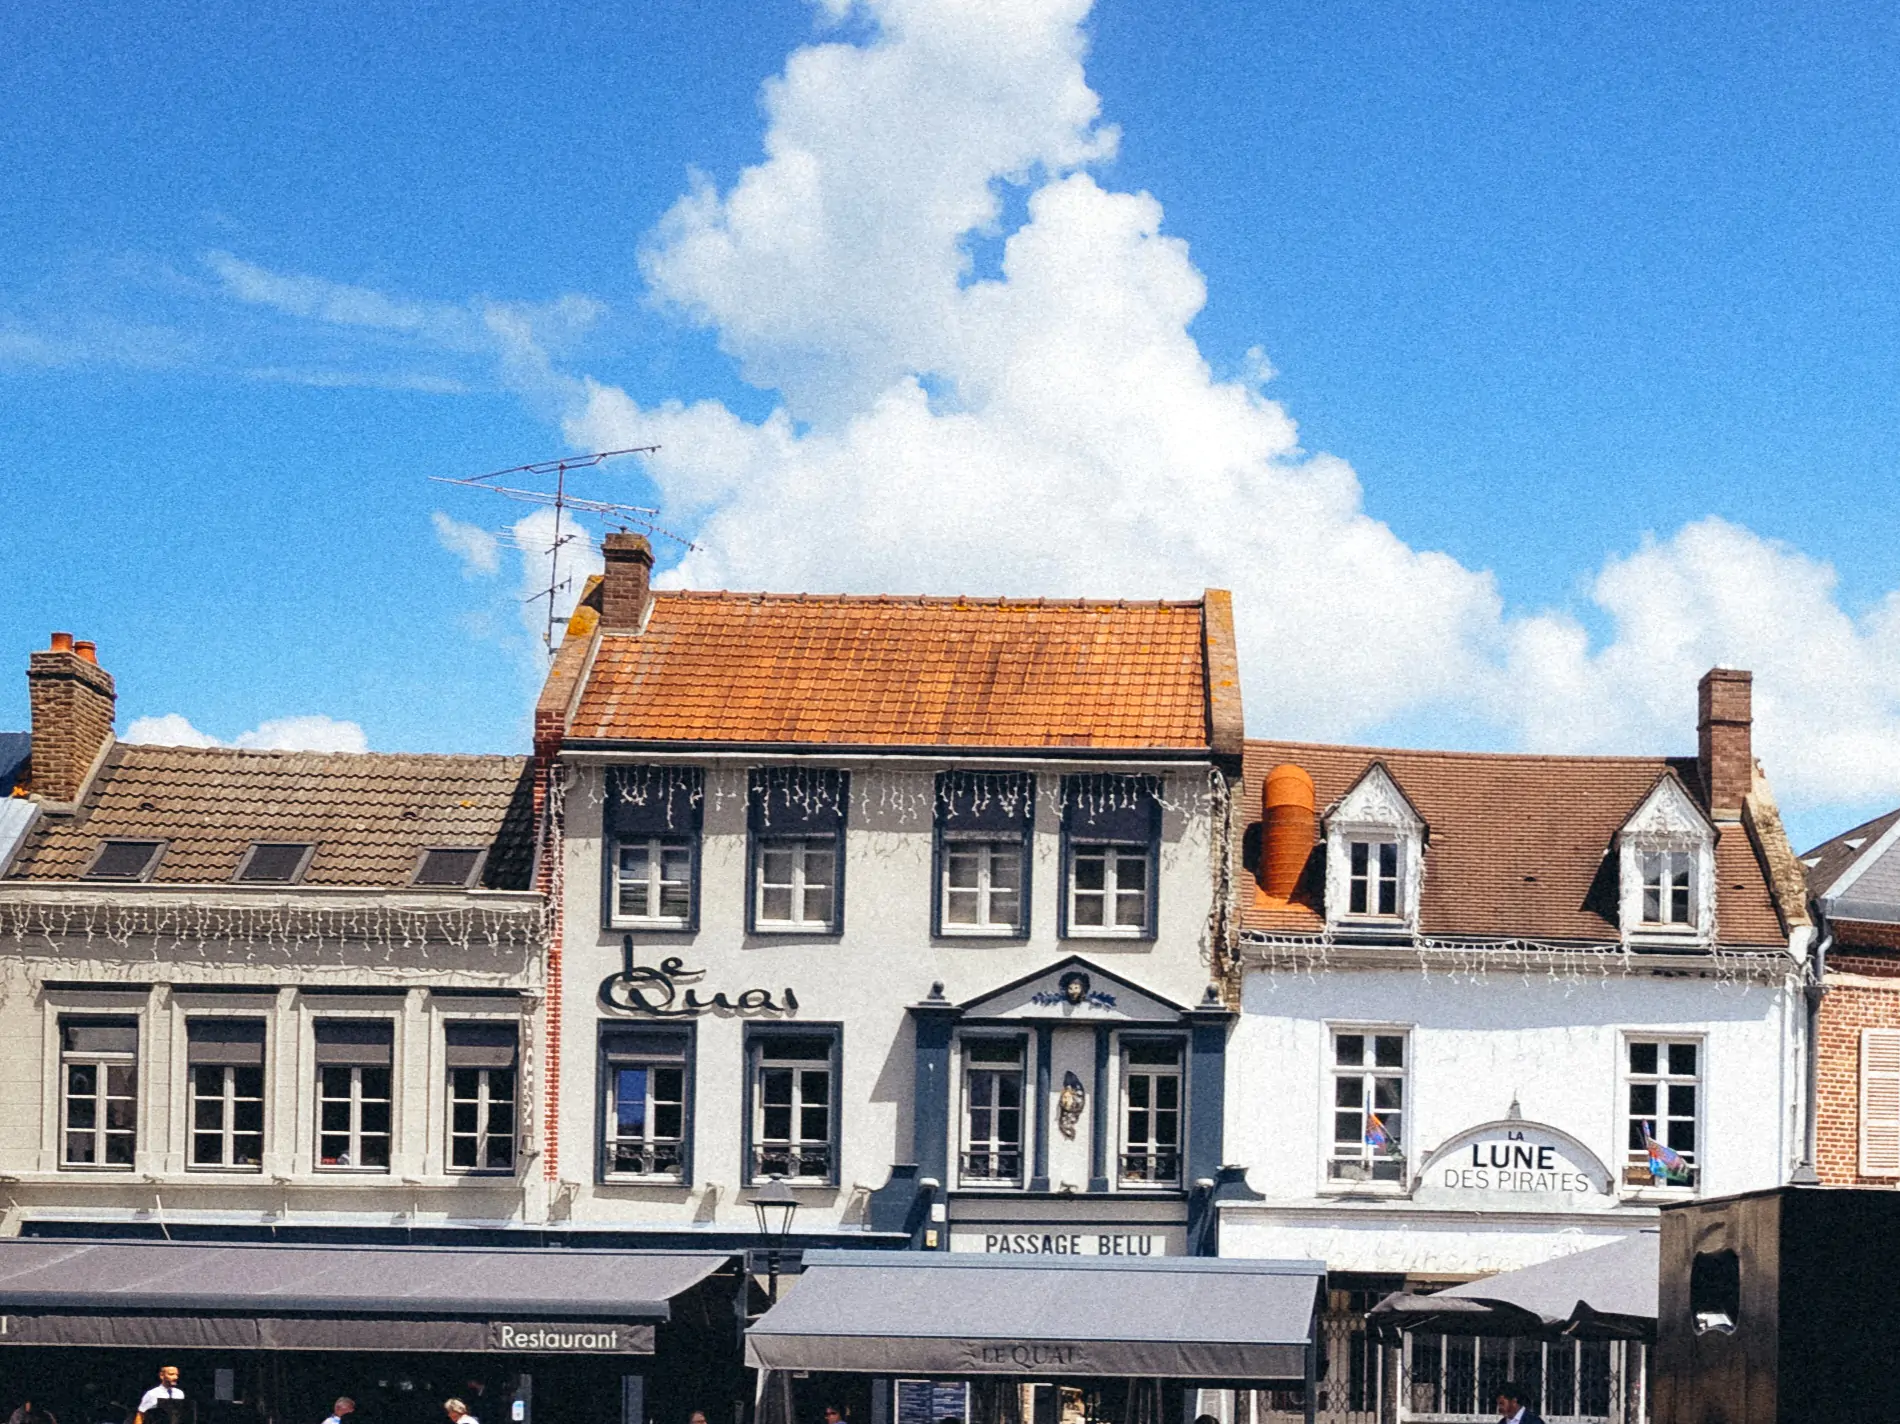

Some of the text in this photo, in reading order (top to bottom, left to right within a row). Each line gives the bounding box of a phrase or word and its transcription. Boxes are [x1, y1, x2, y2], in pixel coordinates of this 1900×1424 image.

[622, 934, 706, 982] Le
[600, 966, 799, 1015] Quai
[1508, 1130, 1525, 1141] LA
[1472, 1143, 1555, 1170] LUNE
[1444, 1169, 1589, 1193] DES PIRATES
[985, 1234, 1152, 1256] PASSAGE BELU
[501, 1325, 618, 1348] Restaurant
[982, 1348, 1005, 1364] LE
